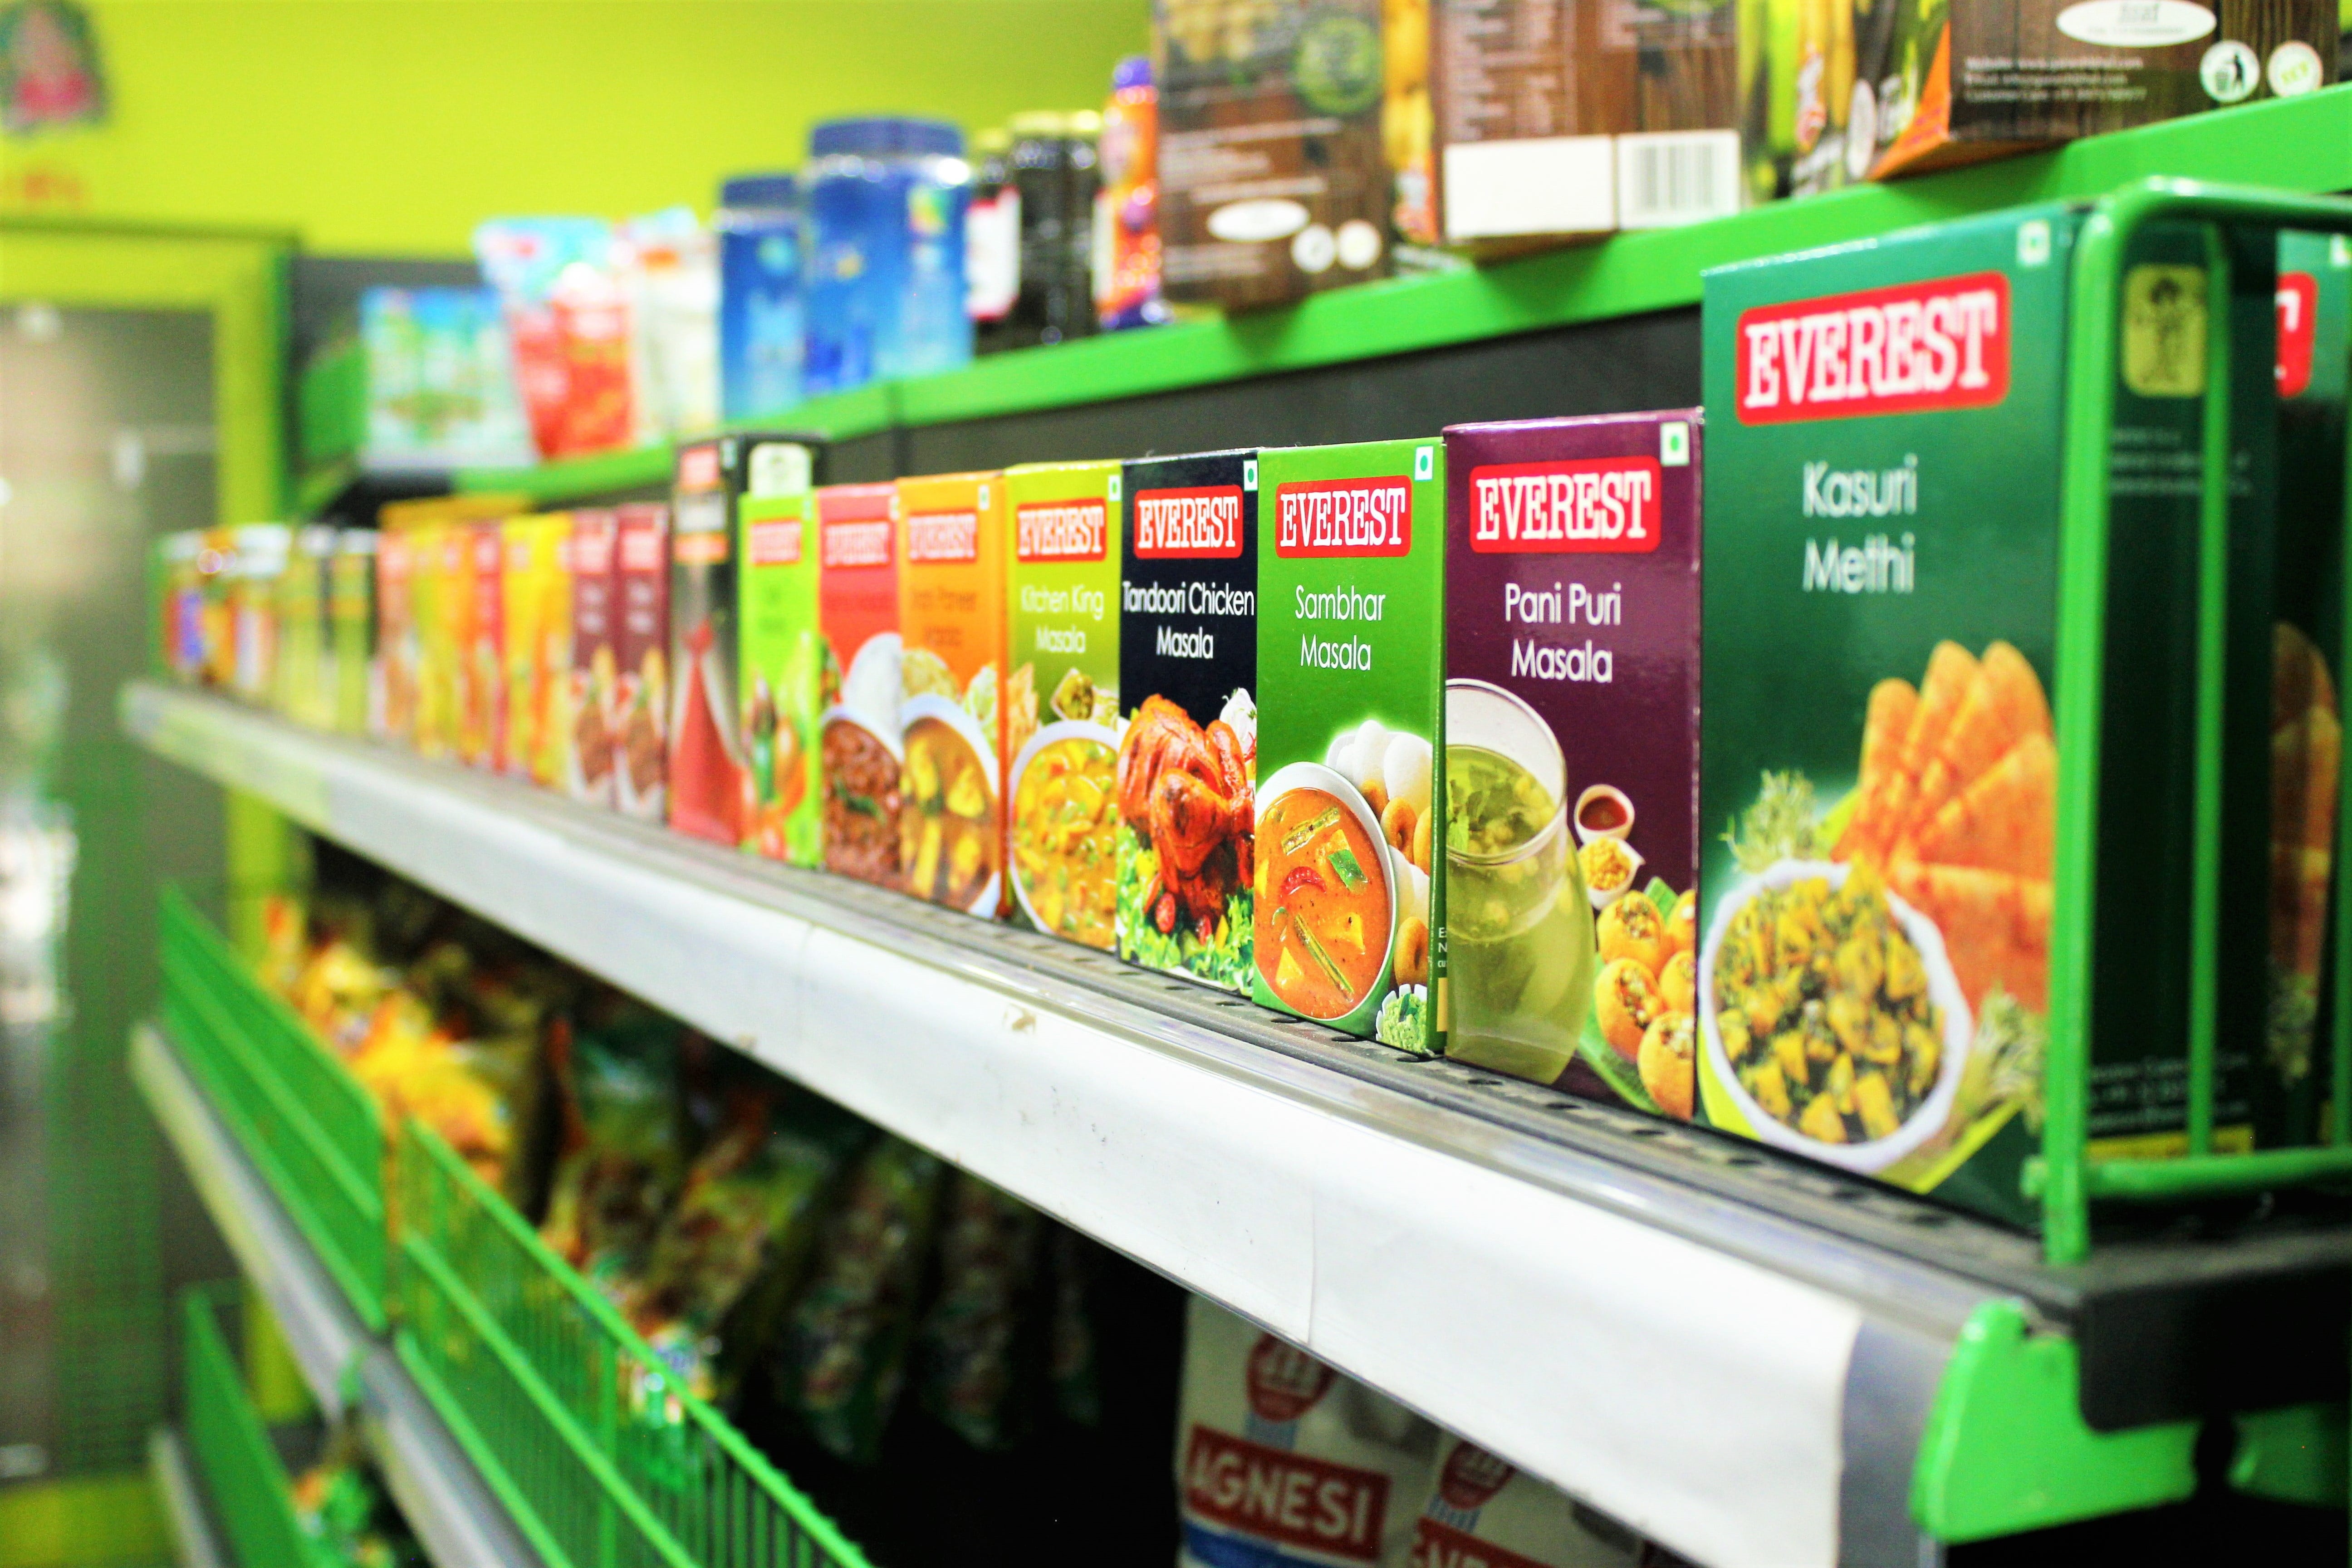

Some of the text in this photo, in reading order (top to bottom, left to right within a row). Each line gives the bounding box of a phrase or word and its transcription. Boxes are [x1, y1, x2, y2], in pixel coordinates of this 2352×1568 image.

[1744, 289, 1997, 408] EVEREST
[1476, 470, 1651, 540] EVEREST
[1803, 452, 1918, 517] Kasuri
[1018, 505, 1104, 556] EVEREST
[1137, 495, 1238, 549] EVEREST
[1279, 487, 1406, 547] EVEREST
[1803, 531, 1915, 593] Methi
[1072, 584, 1104, 621] King
[1122, 581, 1254, 616] Tandoori Chicken
[1294, 585, 1386, 621] Sambhar
[1505, 581, 1622, 626] Pani Puri
[1036, 624, 1087, 653] Masala
[1156, 625, 1214, 659] Masala
[1300, 633, 1371, 671] Masala
[1511, 638, 1612, 683] Masala
